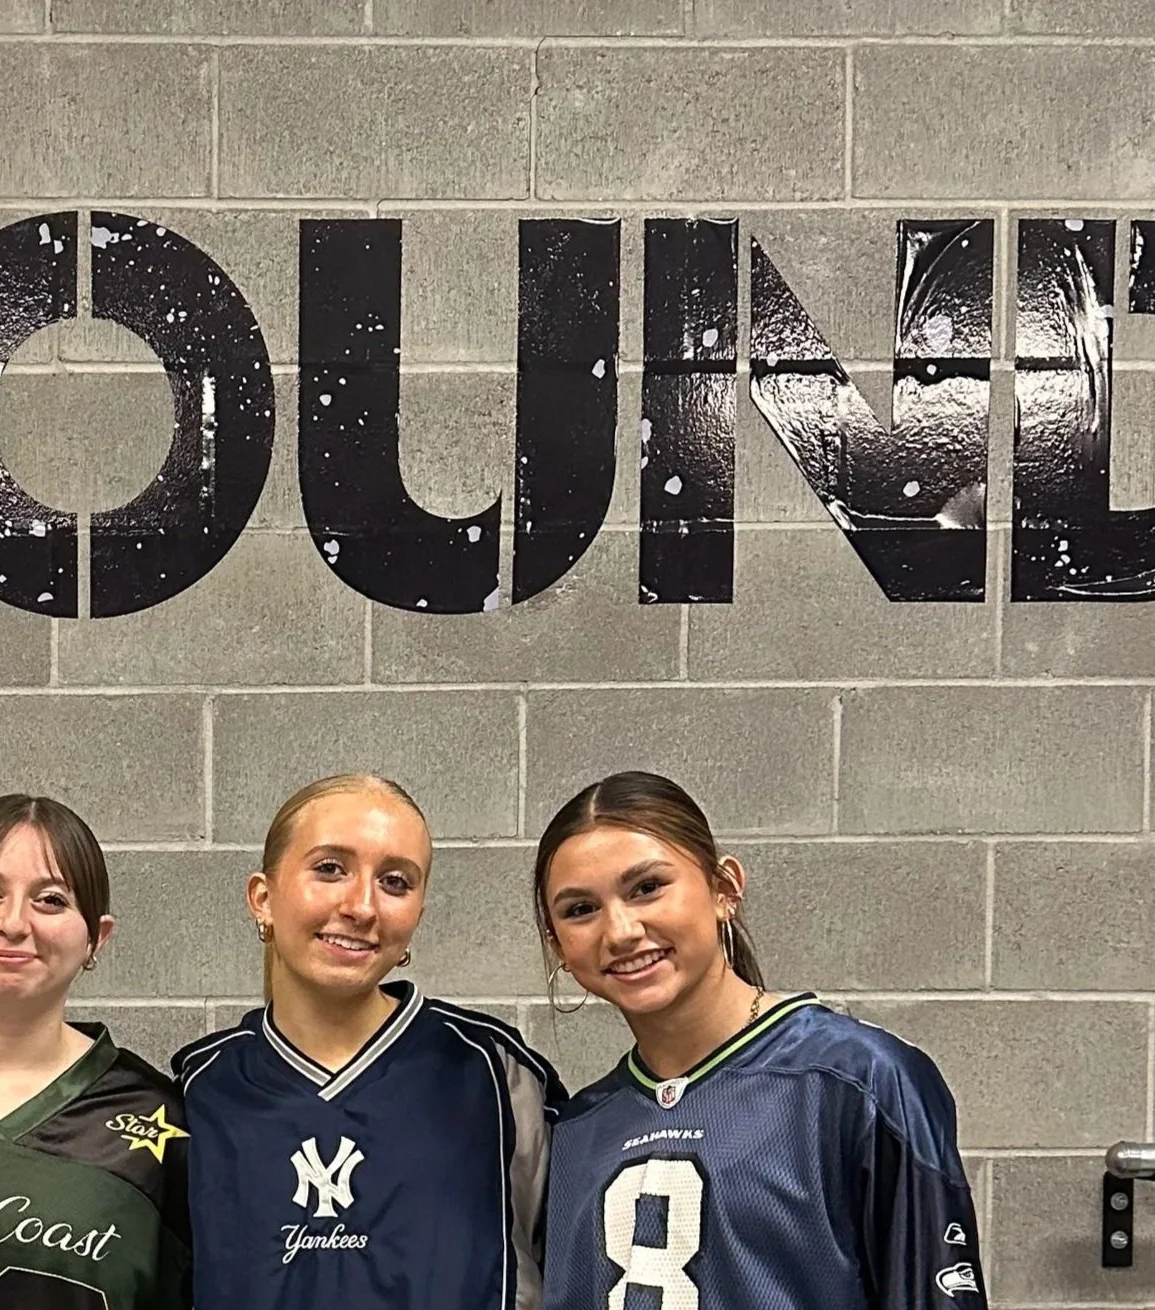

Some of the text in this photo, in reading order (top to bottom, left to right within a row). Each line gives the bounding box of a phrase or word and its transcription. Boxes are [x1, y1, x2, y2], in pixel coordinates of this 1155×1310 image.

[105, 1113, 158, 1138] Star
[622, 1129, 704, 1151] SEAHAWKS
[281, 1224, 368, 1265] Yankees
